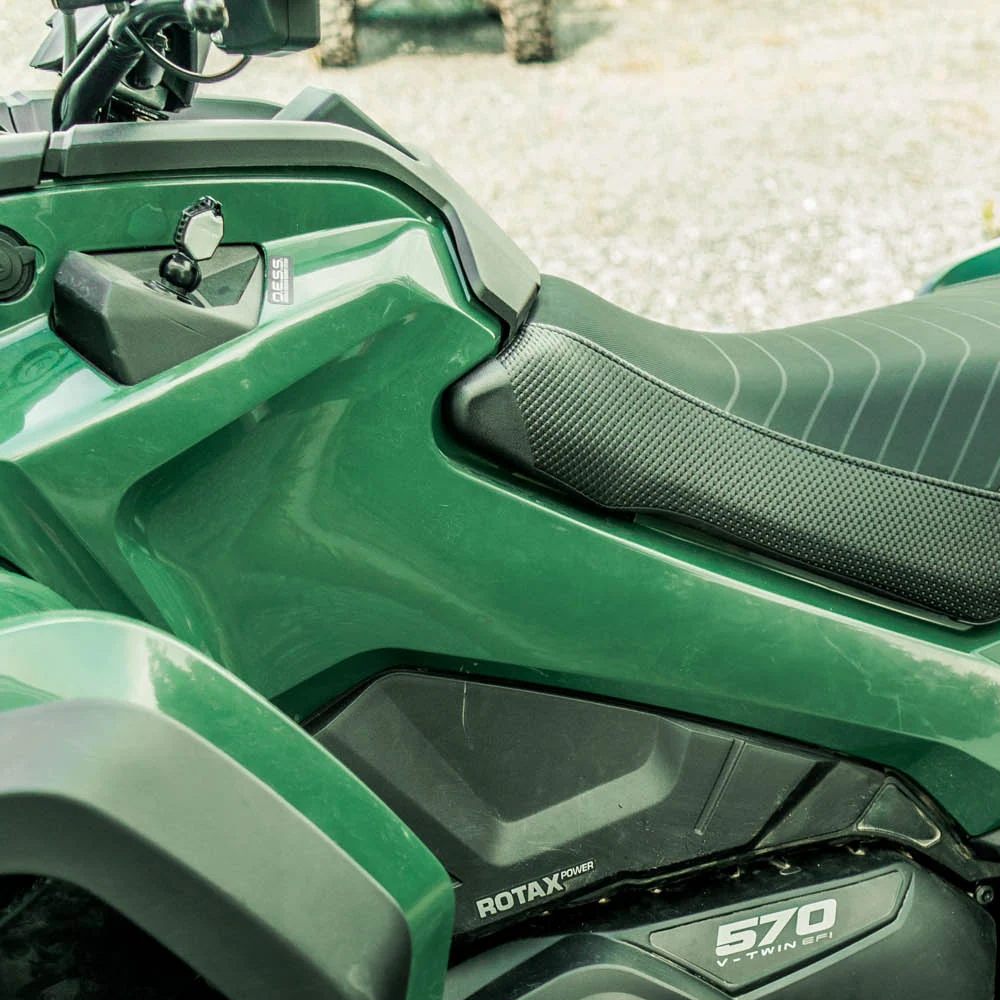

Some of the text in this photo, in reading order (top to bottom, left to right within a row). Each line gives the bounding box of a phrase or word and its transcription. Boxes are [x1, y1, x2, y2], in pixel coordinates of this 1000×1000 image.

[476, 860, 594, 919] ROTAX POWER
[716, 898, 837, 956] 570
[802, 931, 833, 946] EFI
